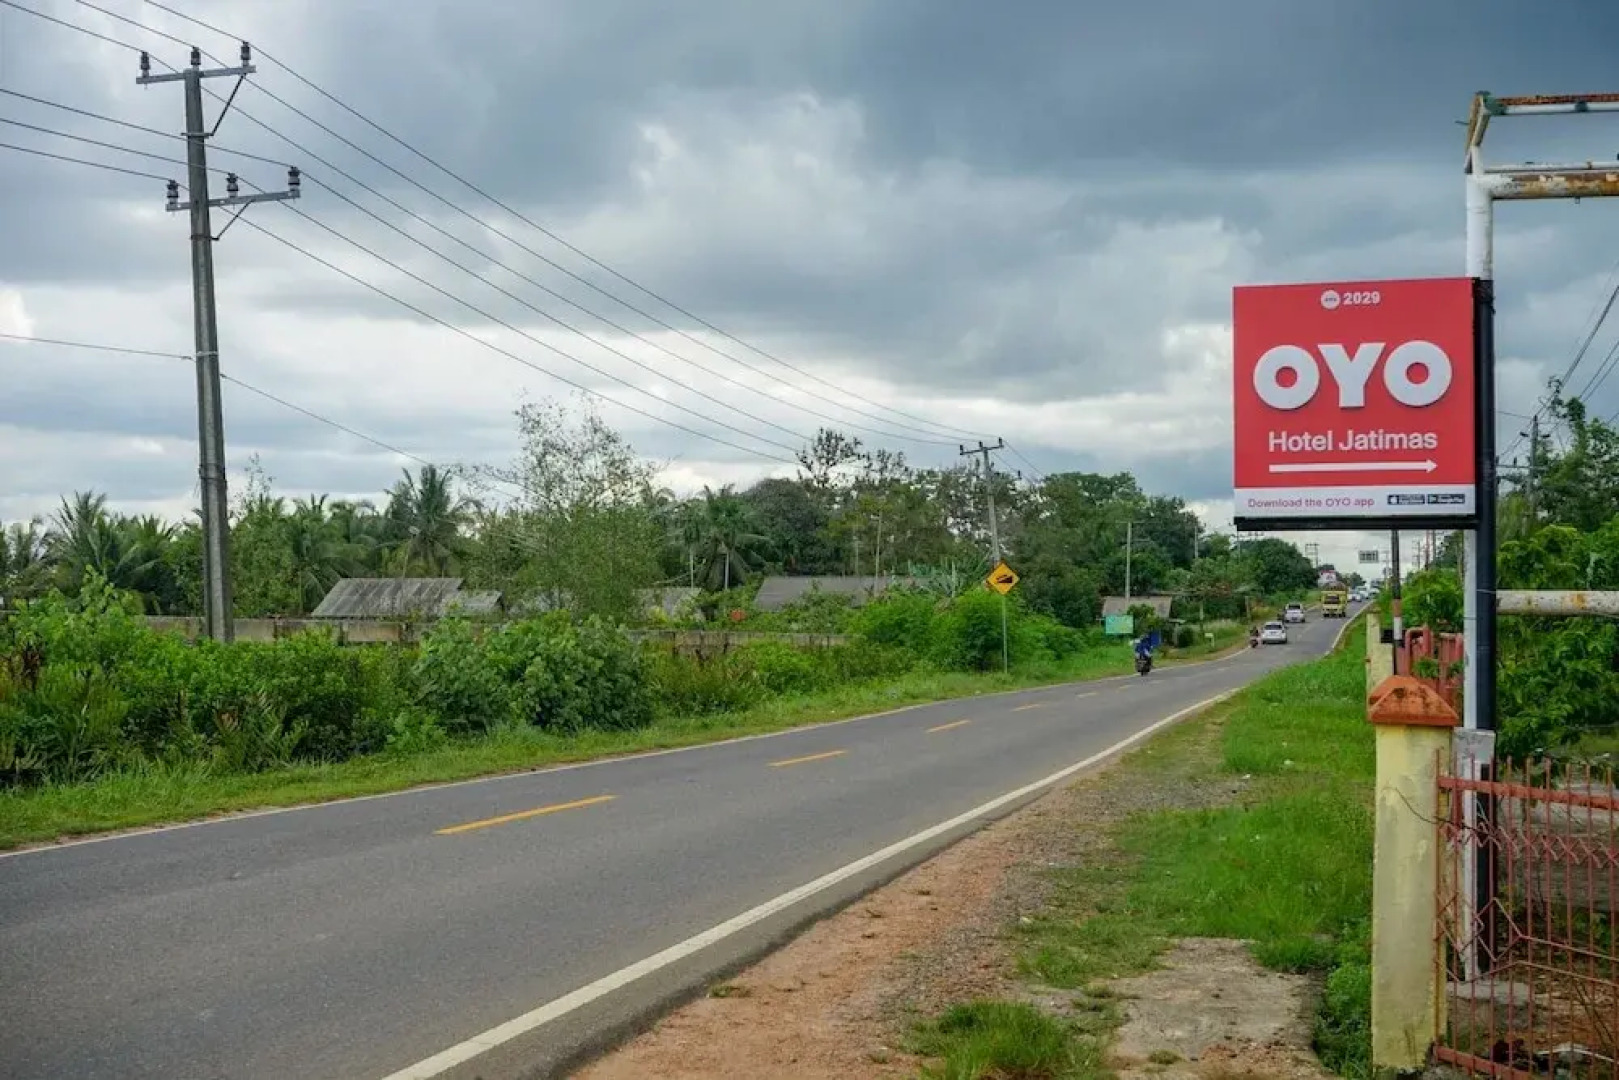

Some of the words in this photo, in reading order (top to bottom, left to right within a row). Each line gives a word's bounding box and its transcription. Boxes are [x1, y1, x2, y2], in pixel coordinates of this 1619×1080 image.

[1343, 291, 1381, 305] 2029
[1253, 340, 1453, 409] OYO
[1268, 430, 1334, 453] Hotel
[1338, 428, 1439, 451] Jatimas
[1248, 498, 1303, 508] Download
[1304, 498, 1323, 508] the
[1325, 497, 1351, 507] OYO
[1354, 498, 1375, 508] app
